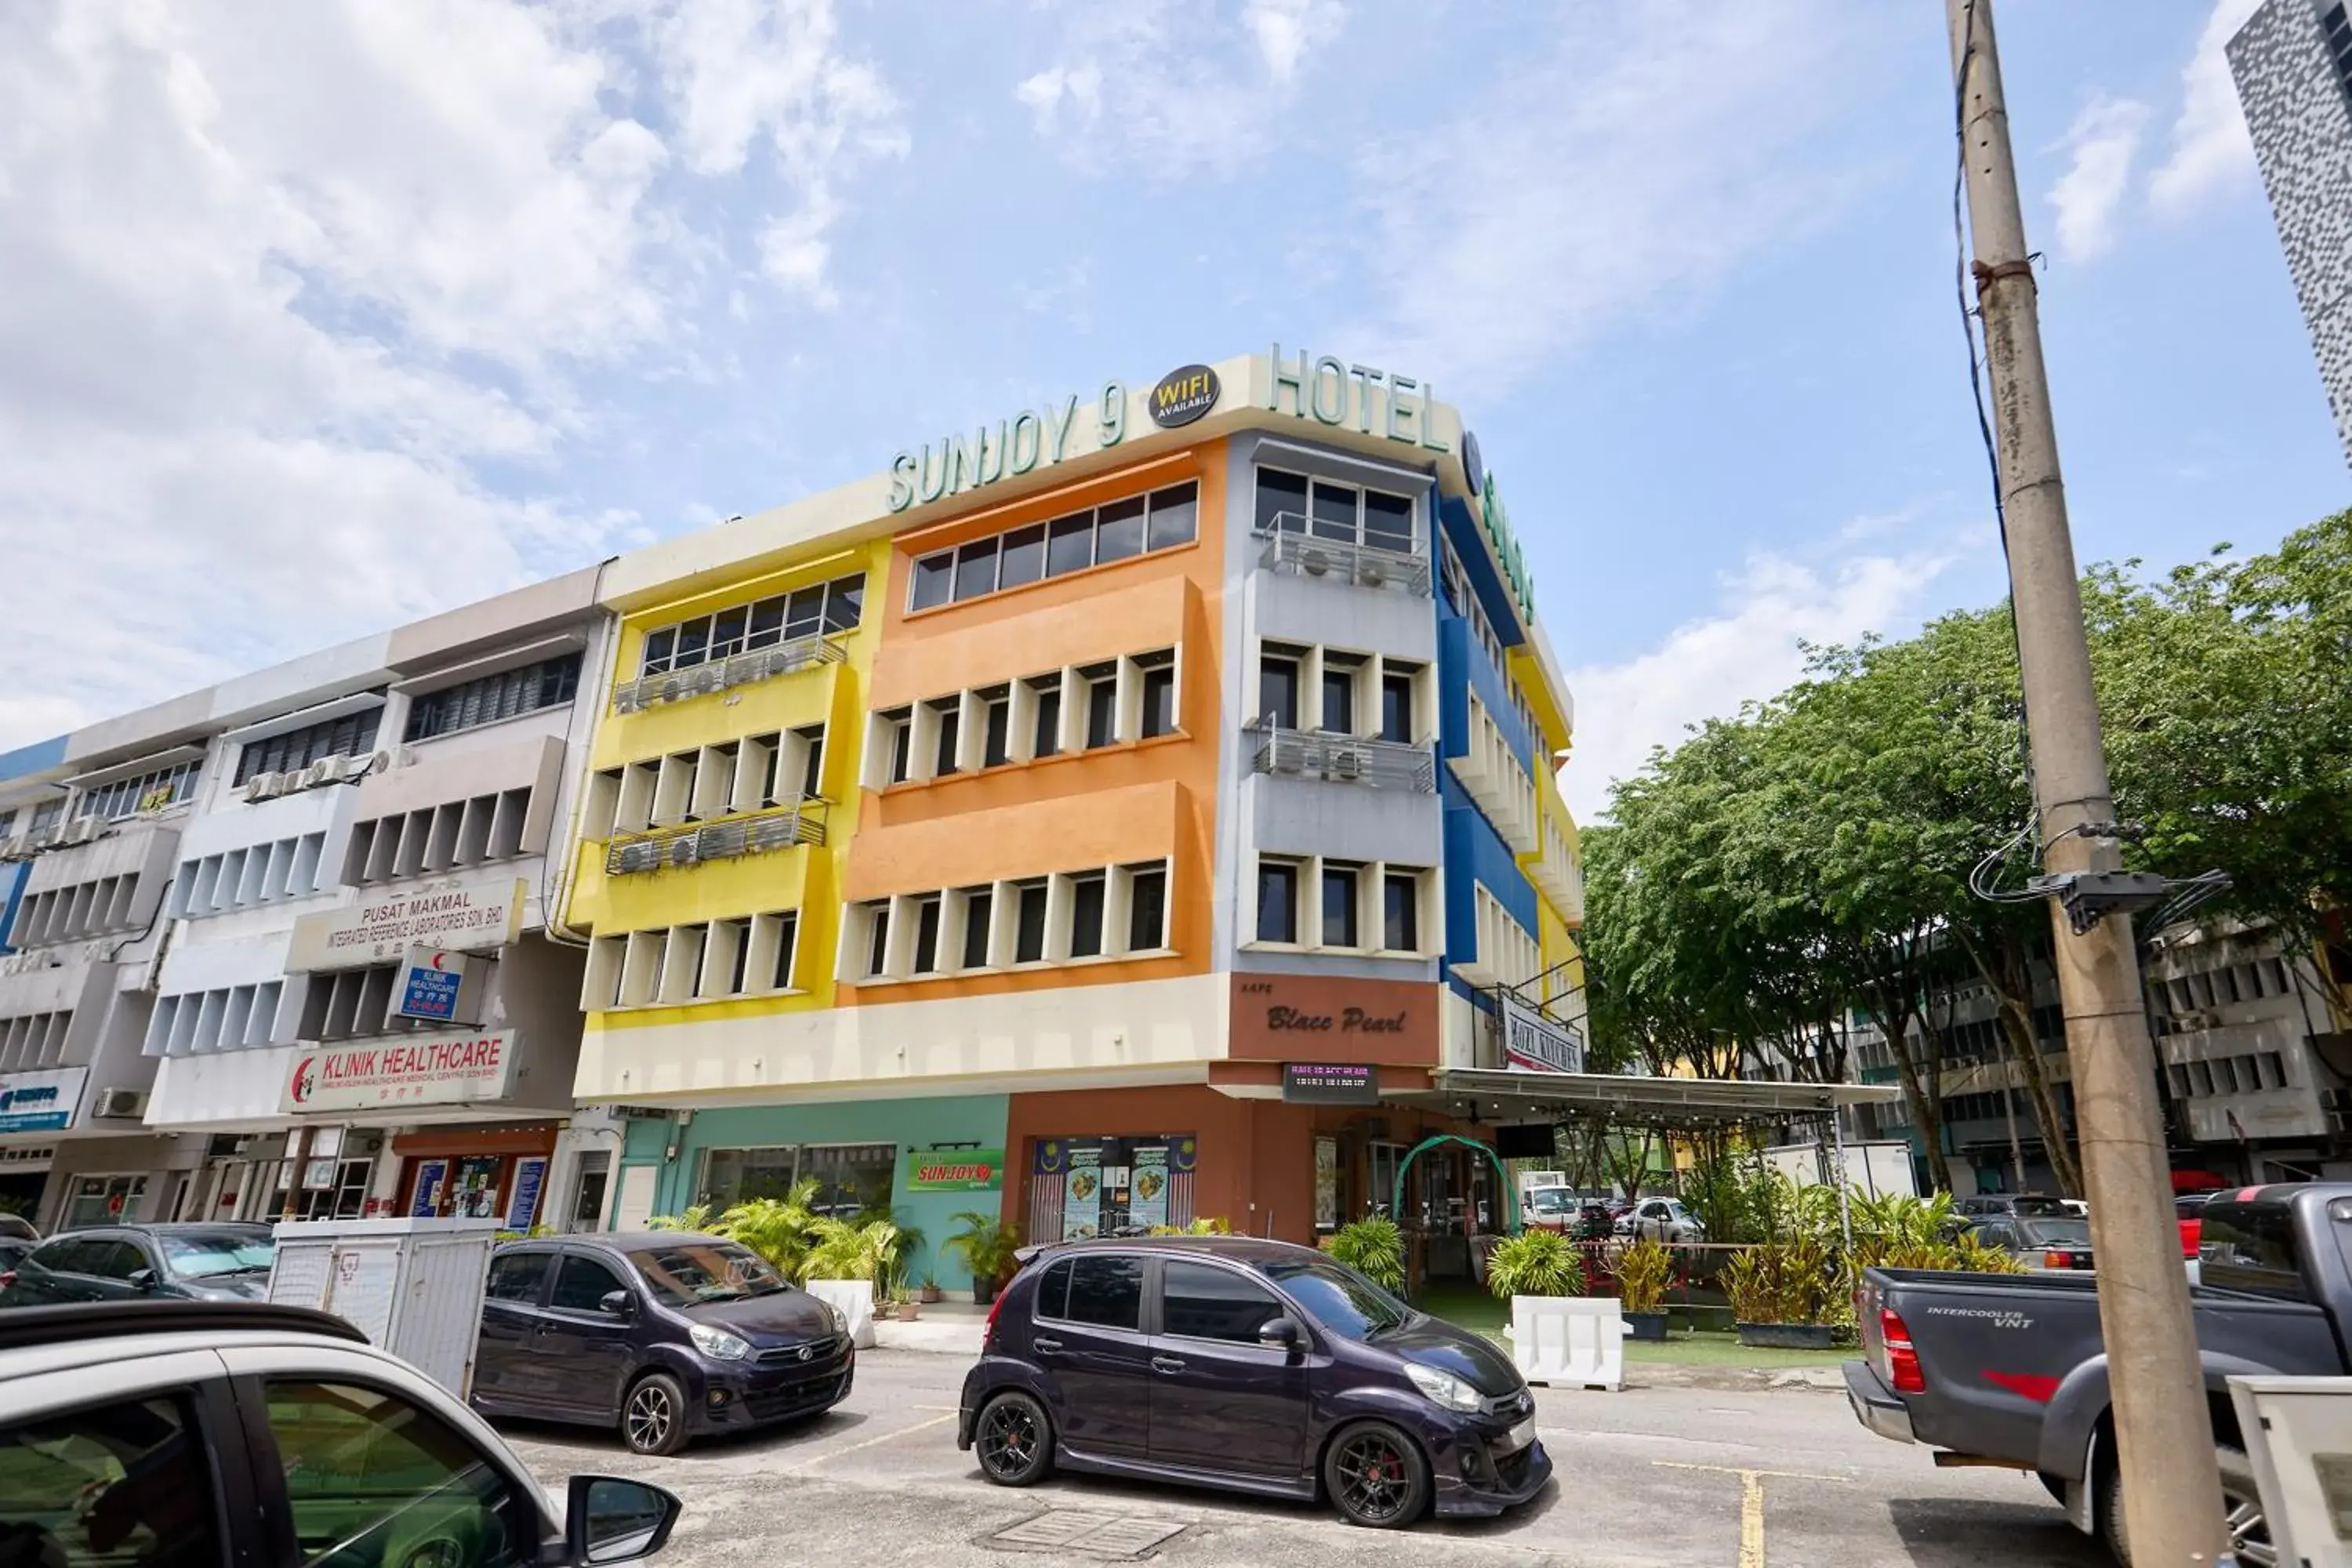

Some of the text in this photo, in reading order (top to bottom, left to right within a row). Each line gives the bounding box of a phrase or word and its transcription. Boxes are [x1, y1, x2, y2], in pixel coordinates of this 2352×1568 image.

[1157, 372, 1210, 407] WIFI
[1269, 342, 1449, 452] HOTEL
[1158, 393, 1212, 420] AVAILABLE
[887, 380, 1126, 514] SUNJOY 9
[362, 891, 470, 923] PUSAT MAKMAL
[327, 927, 368, 949] INTEGRATED
[368, 920, 409, 942] REFERENCE
[409, 912, 466, 936] LABORATORIES
[1341, 1006, 1406, 1033] Pearl
[322, 1038, 503, 1080] KLINIK HEALTHCARE
[1927, 1306, 2025, 1319] INTERCOOLER
[1994, 1318, 2035, 1330] VNT
